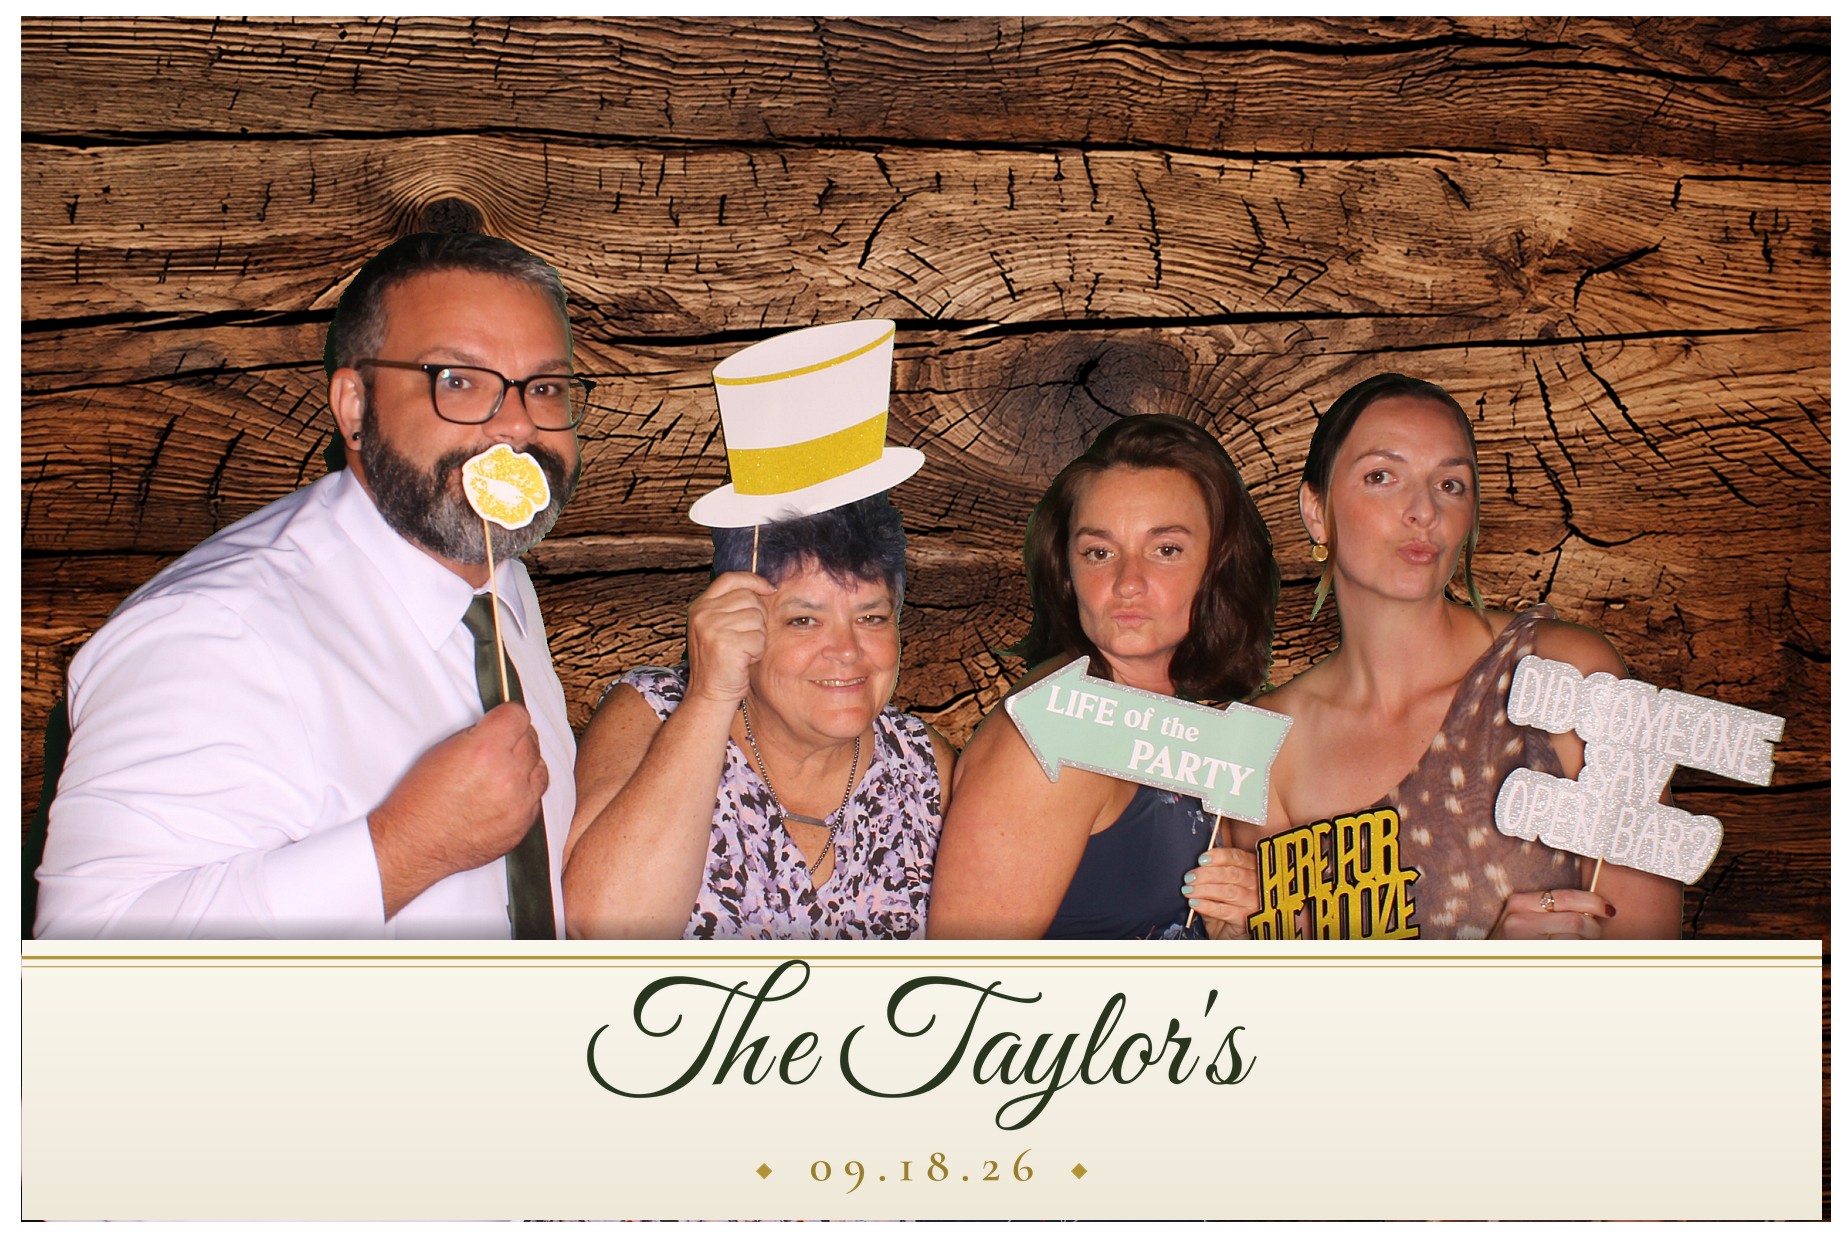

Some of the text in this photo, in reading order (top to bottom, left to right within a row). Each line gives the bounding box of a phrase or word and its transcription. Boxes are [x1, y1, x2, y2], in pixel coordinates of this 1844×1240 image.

[1045, 685, 1200, 743] LIFE of the
[1516, 667, 1773, 777] DID SOMEONE
[1127, 739, 1255, 796] PARTY
[1586, 743, 1668, 807] SAY
[1503, 780, 1711, 876] OPEN BAR?
[1259, 822, 1334, 912] HERE
[1309, 871, 1421, 940] BOOZE
